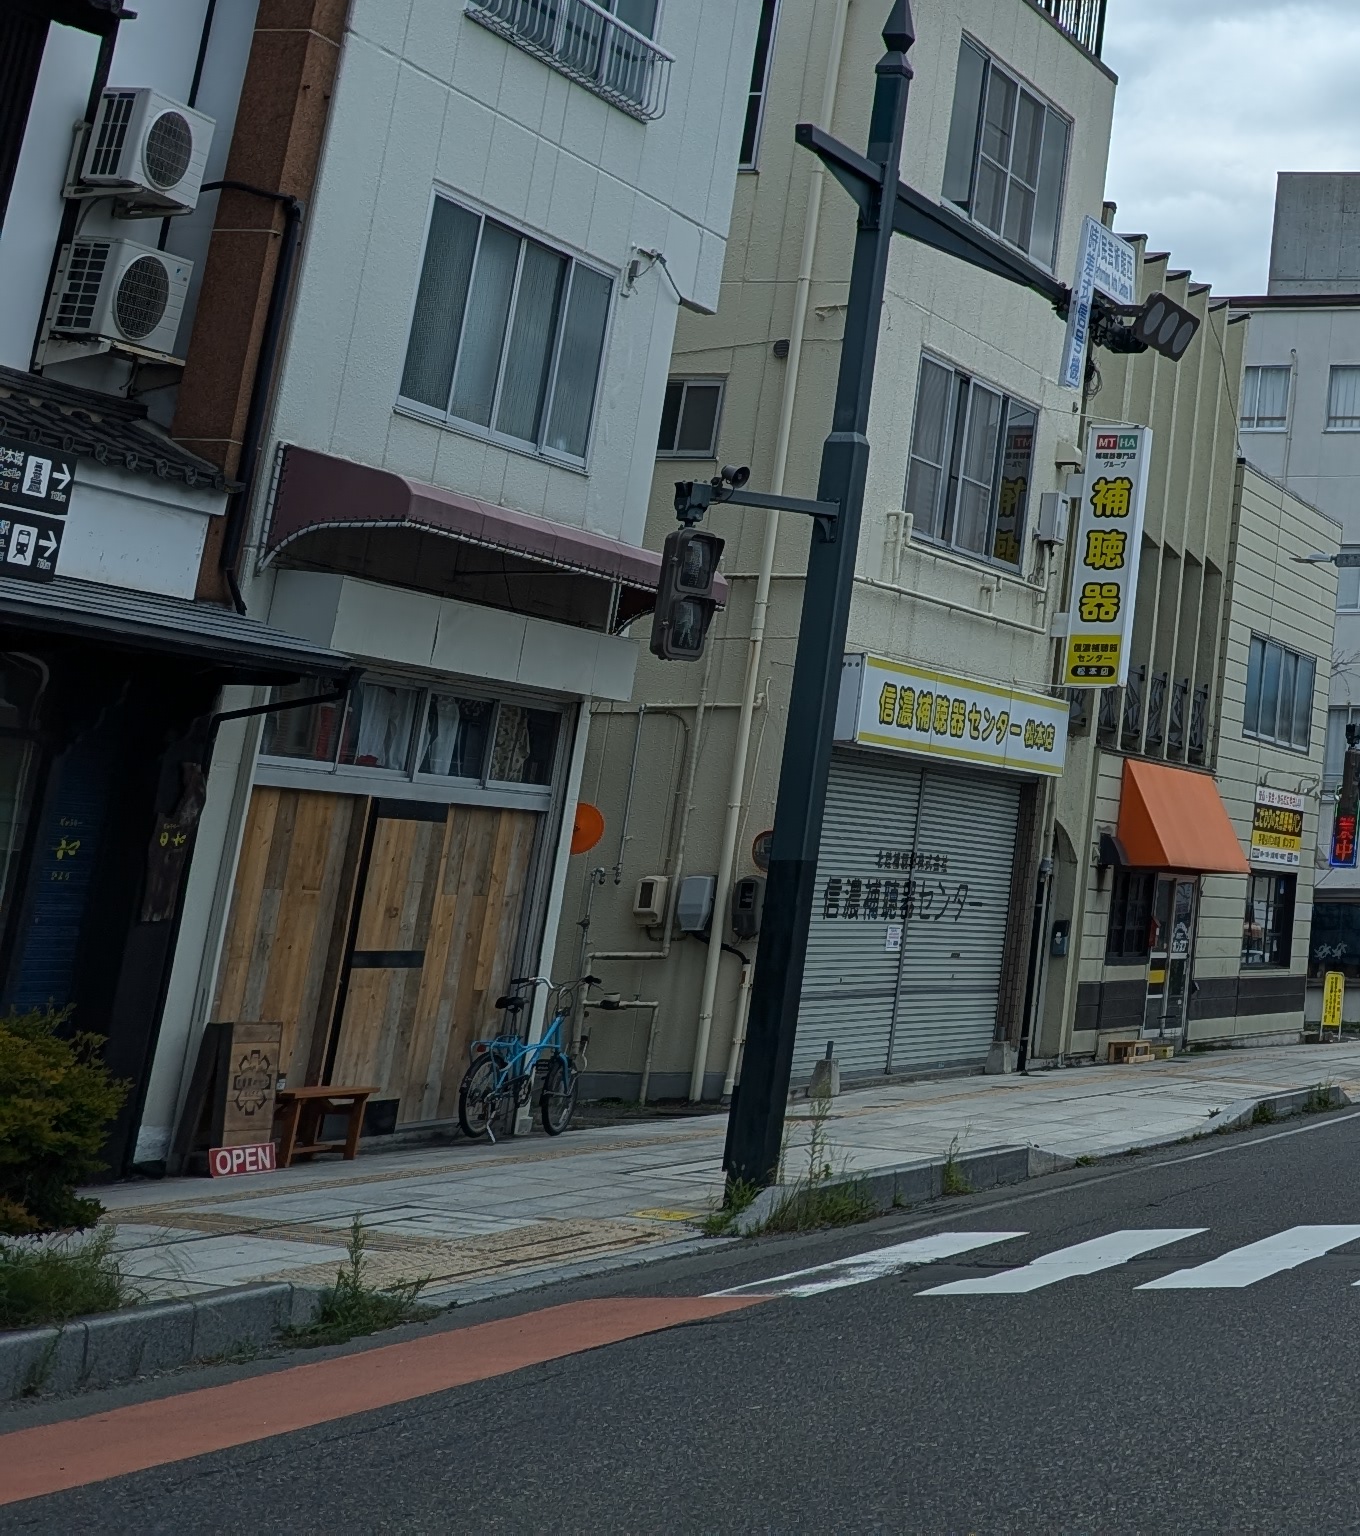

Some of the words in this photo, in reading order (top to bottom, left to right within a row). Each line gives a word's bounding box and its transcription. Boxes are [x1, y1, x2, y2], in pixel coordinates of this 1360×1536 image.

[1098, 437, 1116, 448] MT
[1119, 437, 1136, 448] HA
[1079, 476, 1133, 623] 補聴器
[1077, 654, 1112, 663] センター
[215, 1146, 271, 1175] OPEN
